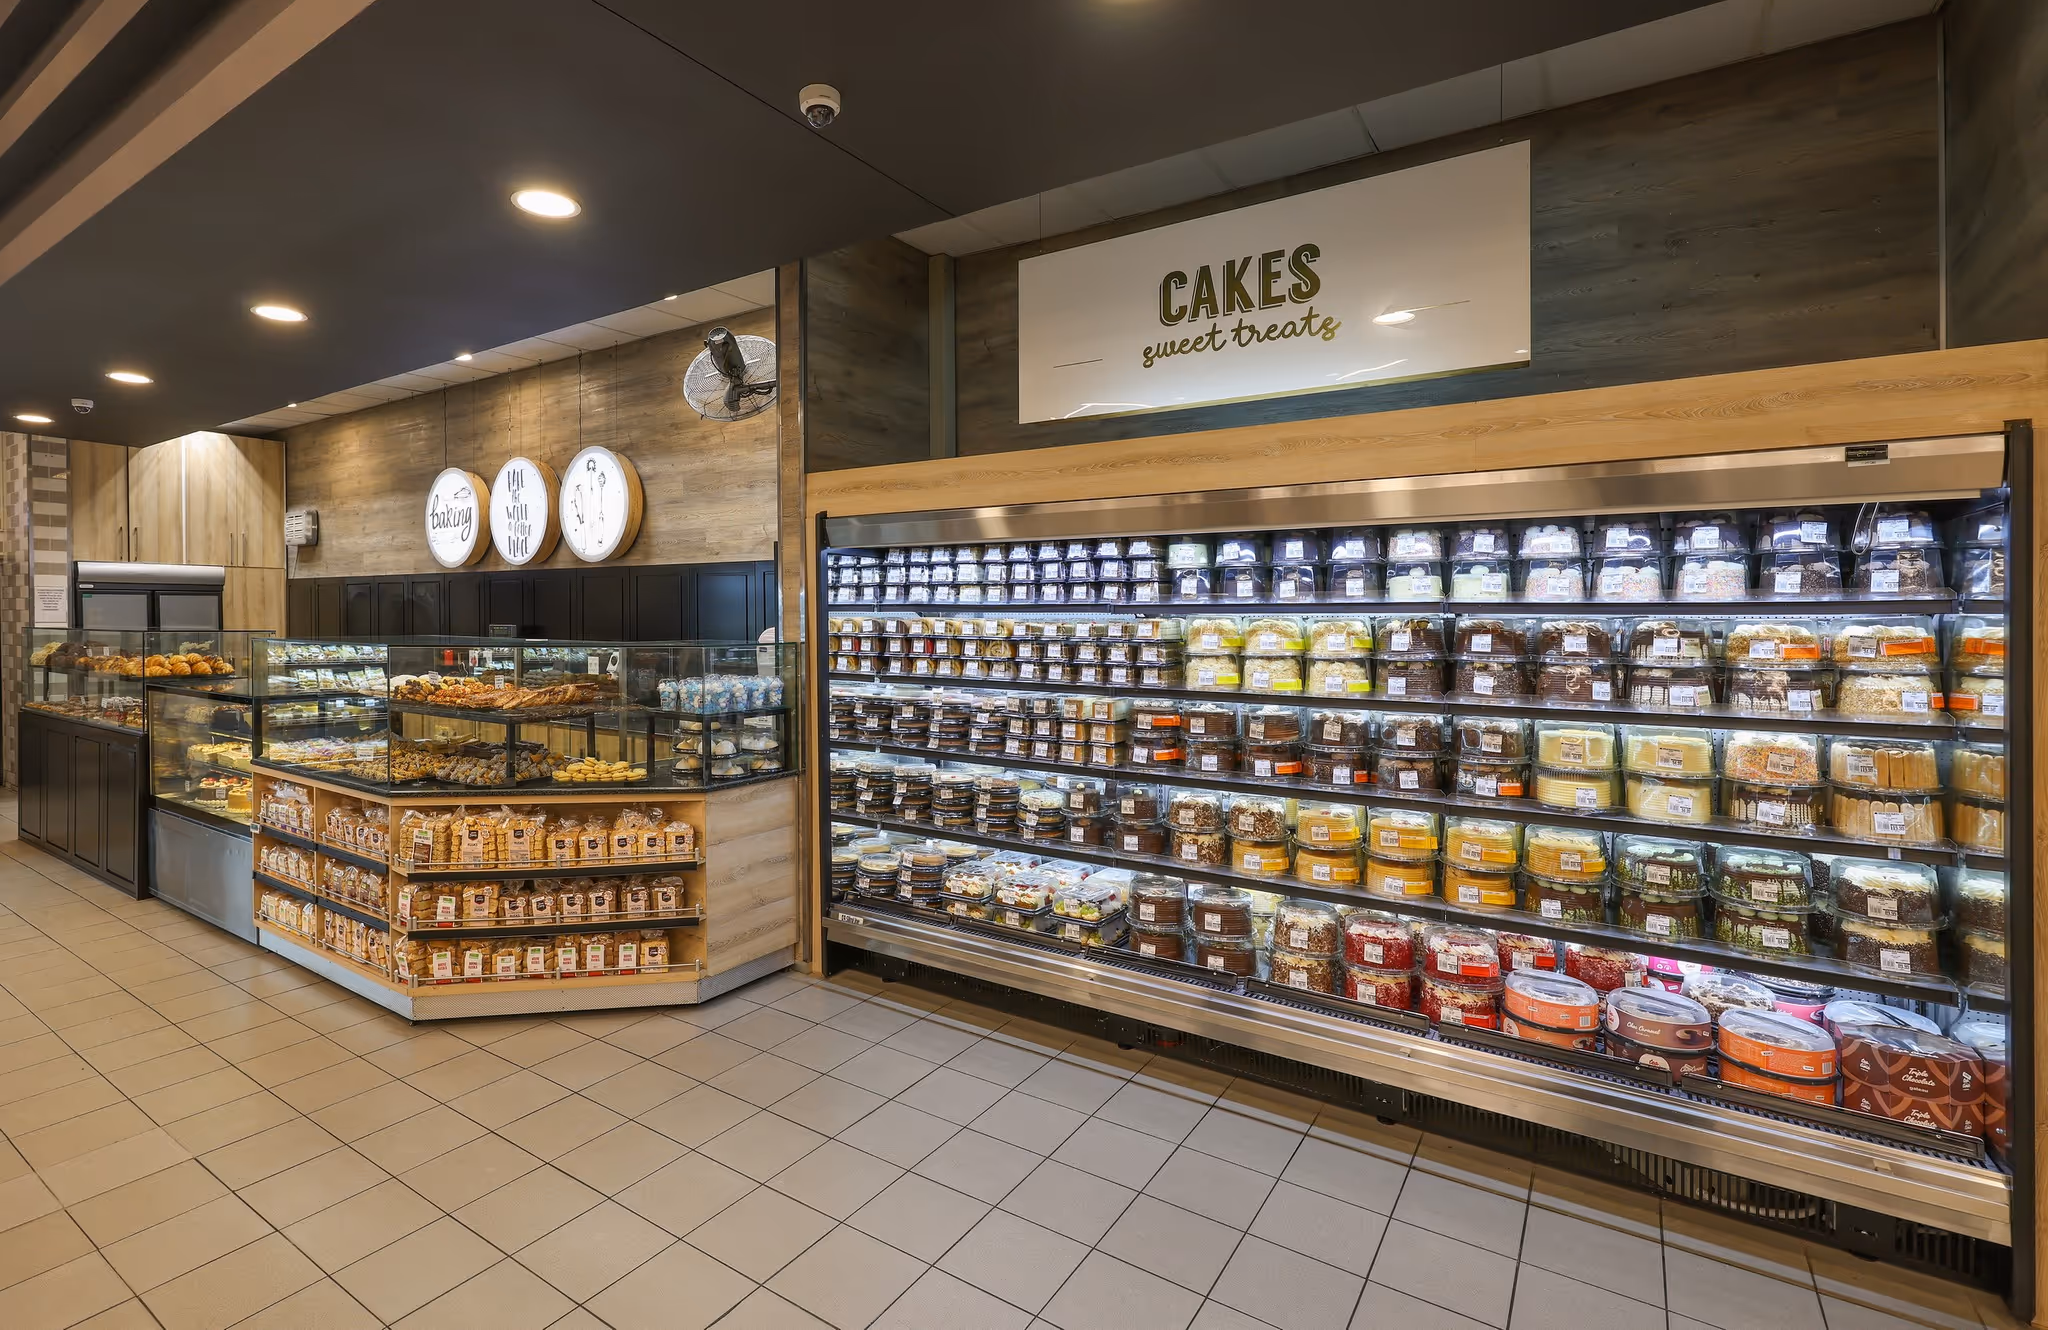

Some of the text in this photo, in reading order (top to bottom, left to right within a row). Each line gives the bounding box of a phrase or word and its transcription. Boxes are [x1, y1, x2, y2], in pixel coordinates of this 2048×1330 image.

[1159, 242, 1321, 327] CAKES
[1142, 306, 1342, 369] sweet treats
[429, 494, 472, 542] baking
[1901, 1074, 1936, 1086] Chocolate
[1908, 1067, 1929, 1078] Triple
[1910, 1108, 1931, 1120] Triple
